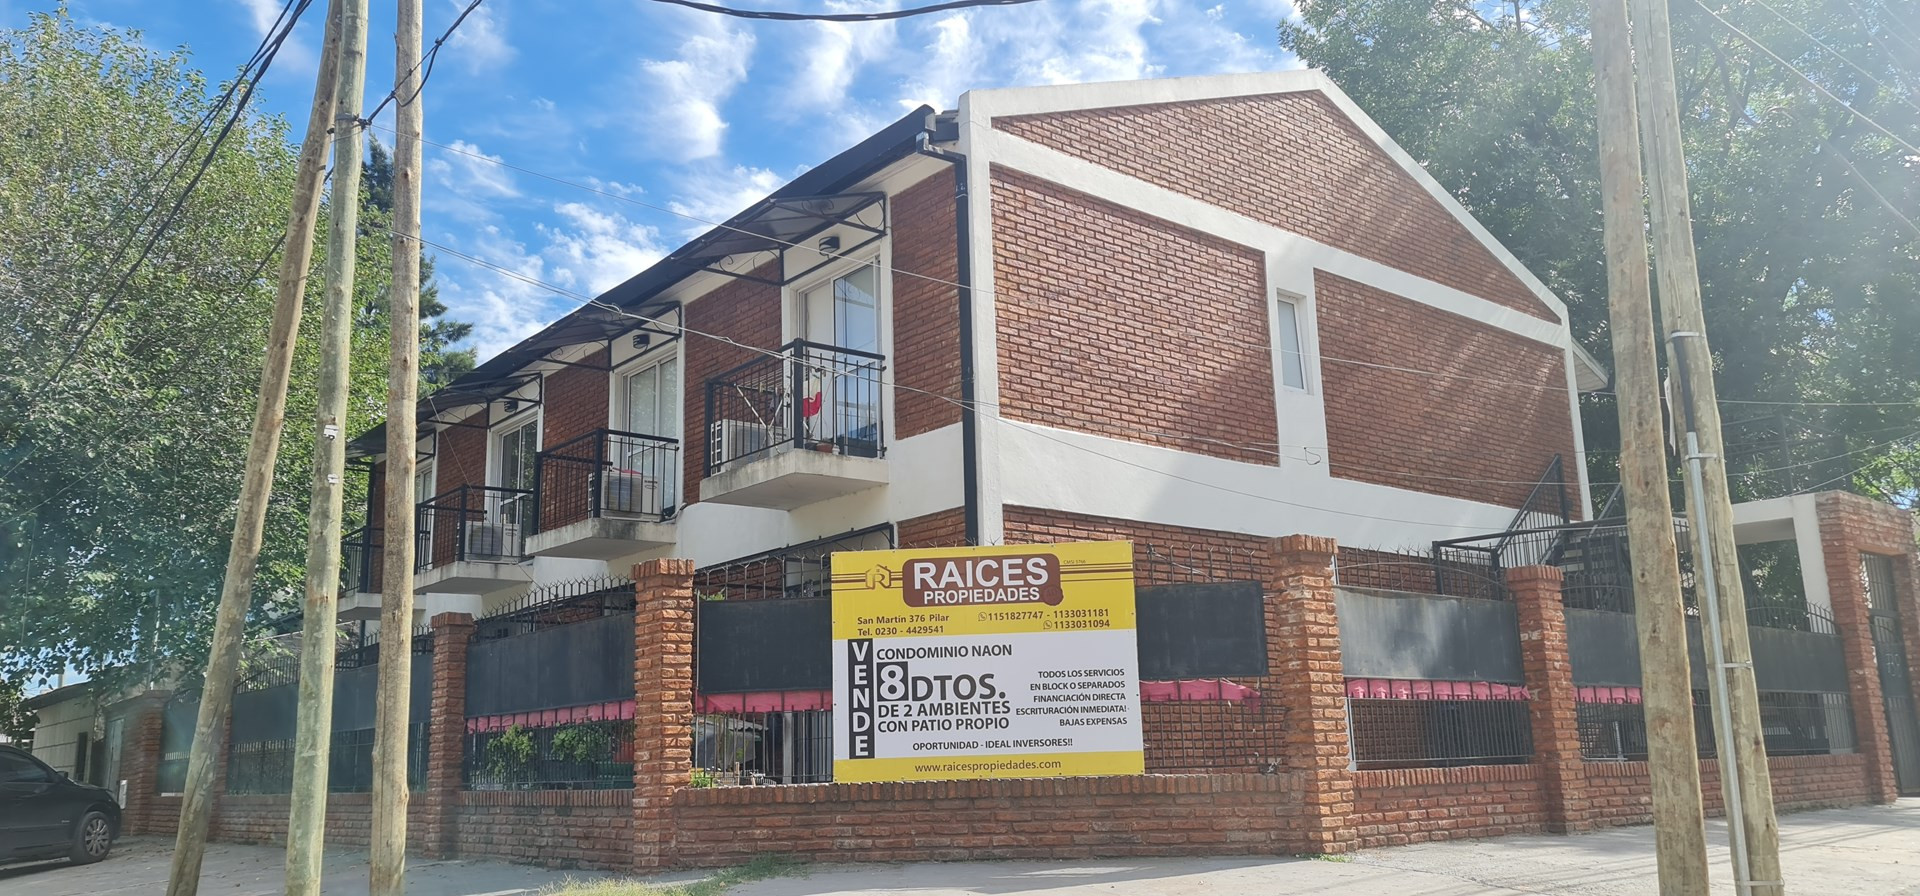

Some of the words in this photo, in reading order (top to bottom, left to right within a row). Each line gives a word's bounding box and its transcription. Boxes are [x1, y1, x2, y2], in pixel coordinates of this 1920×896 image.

[914, 558, 1048, 590] RAICES
[923, 586, 1040, 605] PROPIEDADES
[857, 616, 874, 625] San
[909, 614, 926, 624] 376
[929, 613, 949, 623] Pilar
[988, 611, 1044, 621] 1151827747
[1053, 608, 1109, 619] 1133031181
[857, 627, 873, 637] Tel.
[875, 626, 897, 636] 0230
[906, 625, 944, 635] 4429541
[1053, 619, 1111, 630] 1133031094
[876, 645, 969, 661] CONDOMINIO
[971, 644, 1012, 657] NAON
[1037, 670, 1066, 679] TODOS
[1067, 669, 1083, 678] LOS
[1083, 668, 1125, 677] SERVICIOS
[879, 664, 905, 701] 8
[911, 673, 1006, 702] DTOS.
[1030, 683, 1041, 691] EN
[1042, 682, 1069, 691] BLOCK
[1069, 681, 1077, 690] O
[1077, 680, 1126, 690] SEPARADOS
[851, 641, 871, 757] VENDE
[1033, 692, 1091, 703] FINANCIACIÓN
[1092, 692, 1126, 701] DIRECTA
[878, 705, 900, 719] DE
[903, 703, 913, 718] 2
[916, 700, 1011, 718] AMBIENTES
[1016, 705, 1079, 716] ESCRITURACIÓN
[1080, 704, 1127, 714] INMEDIATA!
[877, 720, 908, 733] CON
[911, 718, 952, 732] PATIO
[955, 716, 1010, 731] PROPIO
[1059, 718, 1085, 727] BAJAS
[1085, 717, 1128, 726] EXPENSAS
[912, 740, 978, 751] OPORTUNIDAD
[985, 739, 1012, 749] IDEAL
[1012, 738, 1073, 748] INVERSORES!!
[914, 759, 1062, 774] www.raicespropiedades.com
